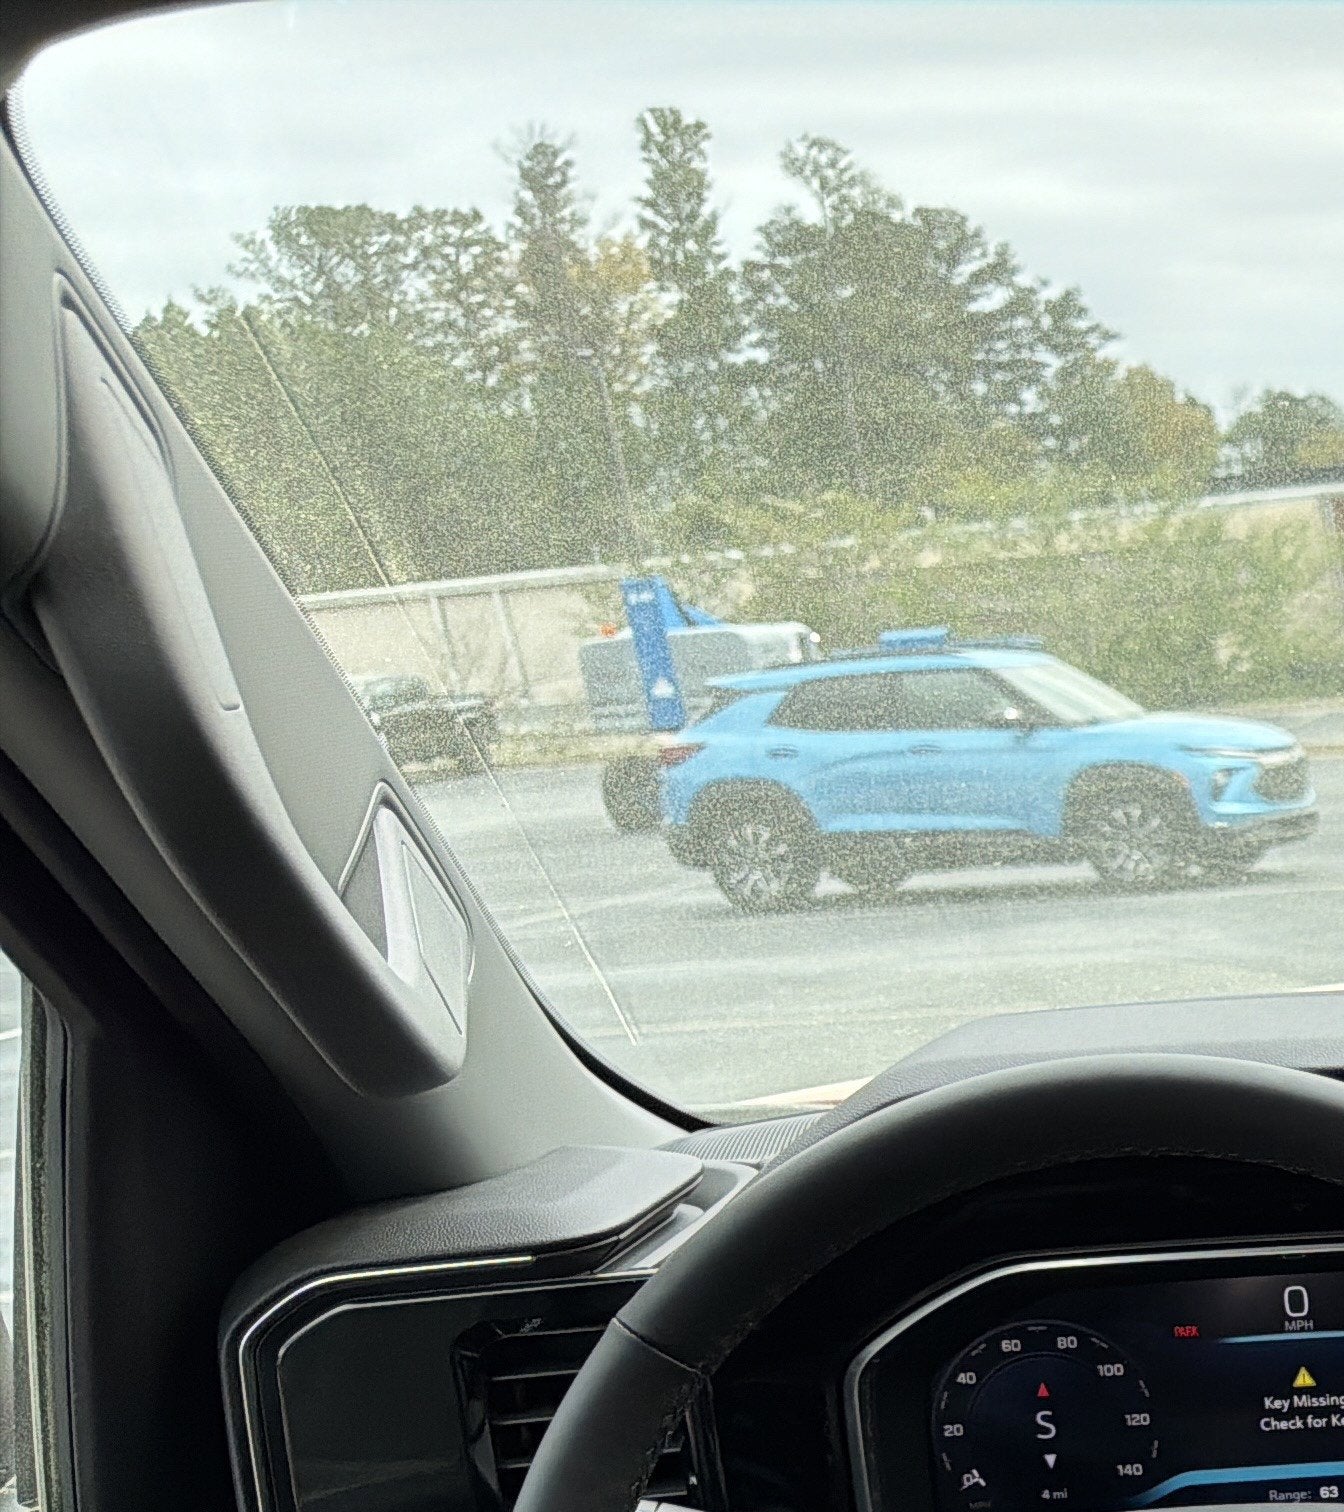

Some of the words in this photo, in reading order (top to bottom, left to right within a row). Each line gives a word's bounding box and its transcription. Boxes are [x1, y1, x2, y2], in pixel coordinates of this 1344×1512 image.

[1284, 1319, 1314, 1332] MPH
[1001, 1339, 1021, 1352] 60
[1057, 1336, 1077, 1349] 80
[1097, 1363, 1124, 1376] 100
[956, 1371, 977, 1385] 40
[1263, 1396, 1290, 1412] Key
[1036, 1410, 1057, 1439] S
[1124, 1413, 1150, 1426] 120
[1260, 1415, 1304, 1431] Check
[1306, 1414, 1328, 1428] for
[944, 1424, 964, 1437] 20
[1117, 1464, 1142, 1477] 140
[1269, 1489, 1313, 1503] Range:
[1319, 1485, 1339, 1499] 63
